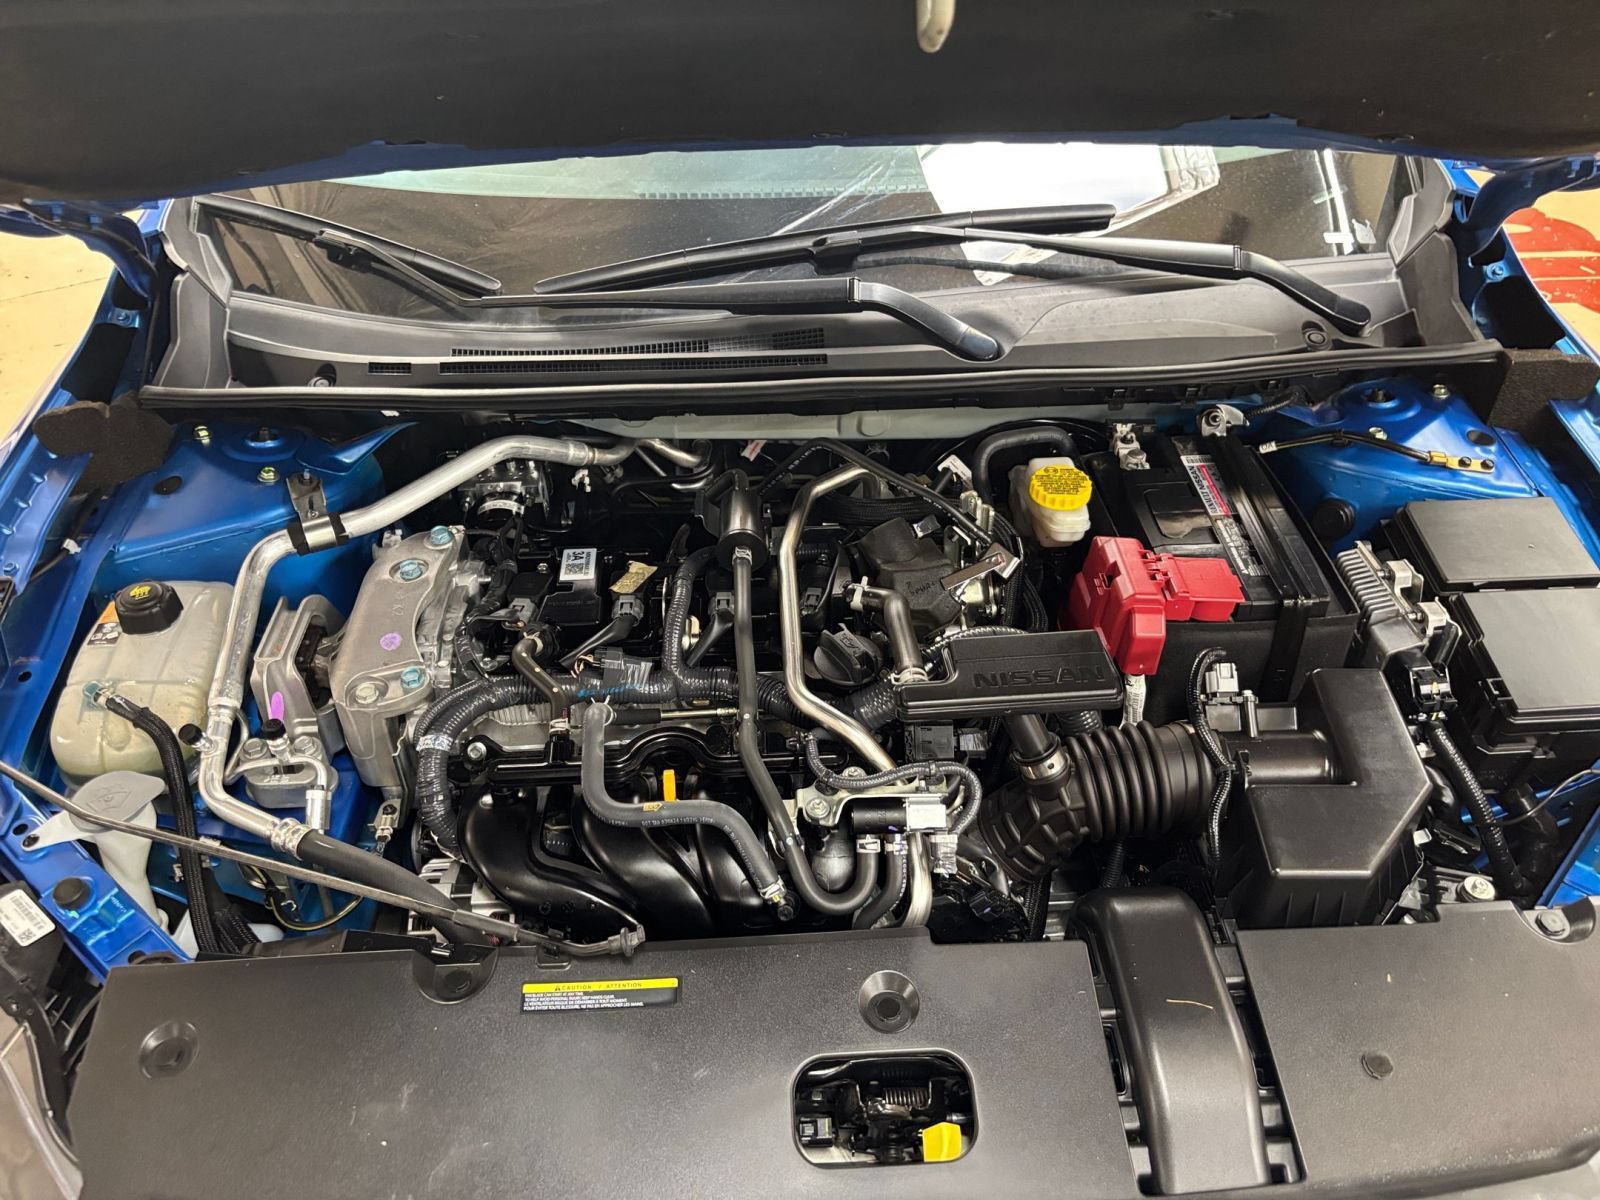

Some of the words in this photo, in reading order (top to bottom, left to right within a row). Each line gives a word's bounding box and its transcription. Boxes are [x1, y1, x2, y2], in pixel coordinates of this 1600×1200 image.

[1188, 465, 1206, 491] NISSAN
[571, 551, 584, 561] 3A
[974, 666, 1106, 688] NISSAN
